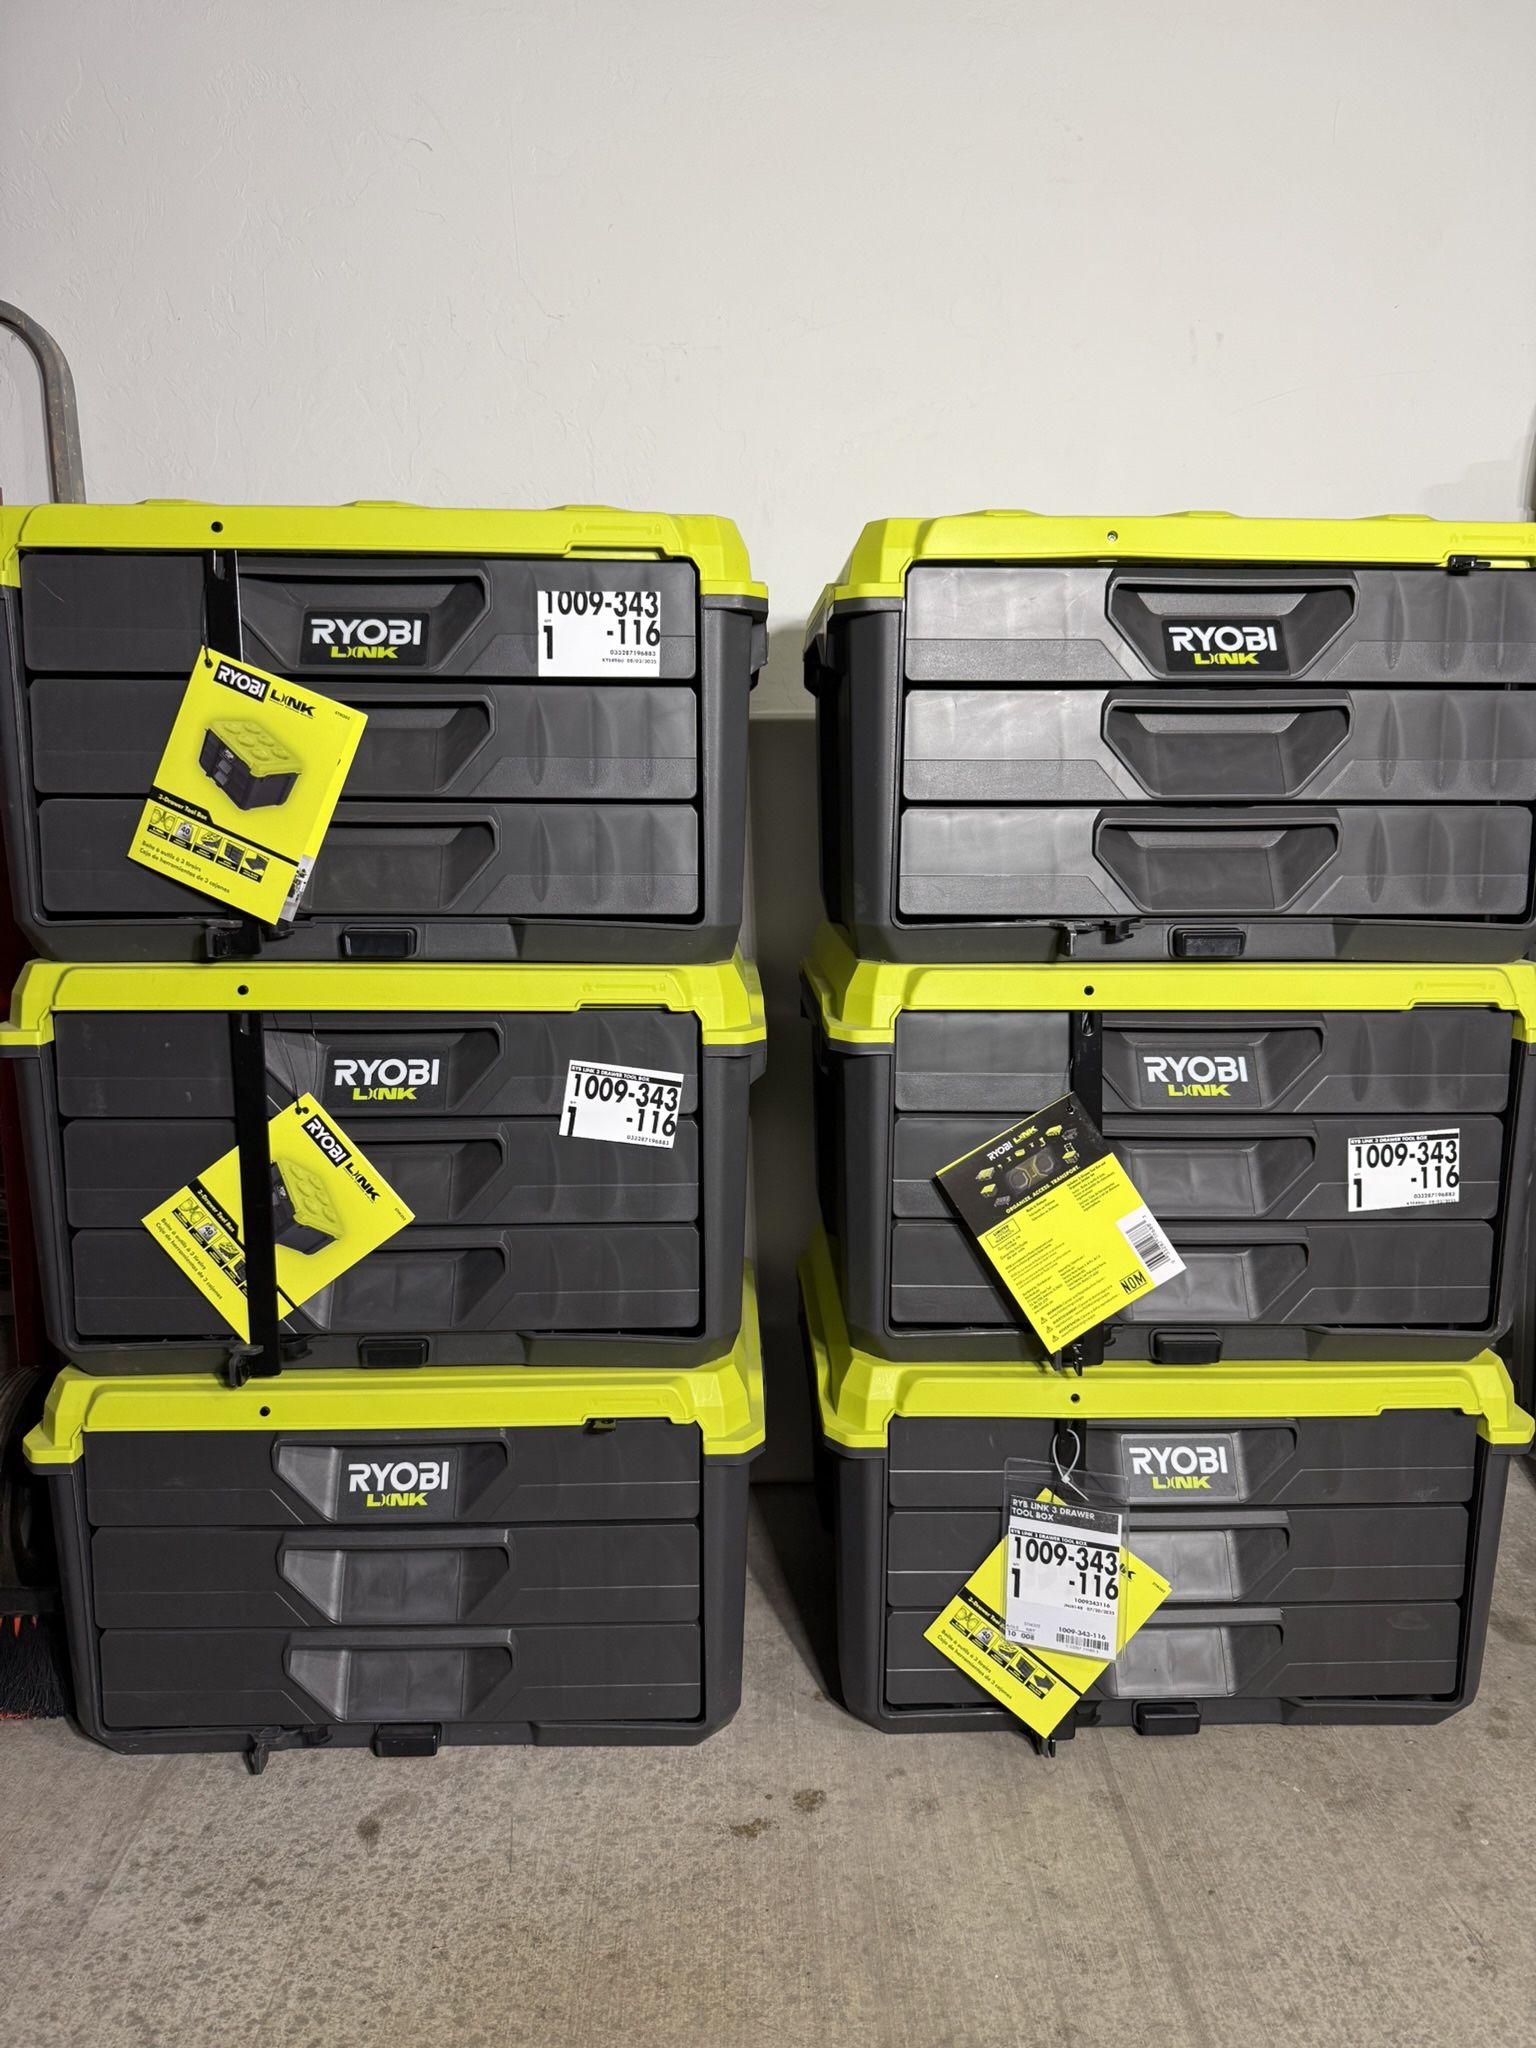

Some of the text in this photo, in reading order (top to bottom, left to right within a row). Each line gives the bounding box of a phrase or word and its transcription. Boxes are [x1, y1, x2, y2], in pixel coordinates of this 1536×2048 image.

[545, 591, 659, 618] 1009-343
[311, 618, 422, 646] RYOBI
[543, 625, 553, 660] 1
[607, 619, 660, 647] -116
[1168, 626, 1278, 652] RYOBI
[330, 646, 399, 659] LINK
[1194, 652, 1260, 665] LINK
[218, 664, 267, 698] RYOBI
[180, 826, 191, 835] 40
[333, 1058, 440, 1086] RYOBI
[1143, 1056, 1249, 1083] RYOBI
[352, 1087, 417, 1101] LINK
[574, 1073, 678, 1112] 1009-343
[1168, 1084, 1230, 1097] LINK
[567, 1105, 577, 1137] 1
[626, 1108, 676, 1137] -116
[306, 1117, 347, 1163] RYOBI
[986, 1140, 1014, 1161] RYOBI
[1355, 1140, 1457, 1168] 1009-343
[1411, 1165, 1460, 1188] -116
[1353, 1178, 1362, 1208] 1
[1120, 1270, 1147, 1294] NOM
[1129, 1446, 1228, 1475] RYOBI
[348, 1461, 450, 1492] RYOBI
[1152, 1475, 1212, 1489] LINK
[366, 1492, 429, 1507] LINK
[1012, 1498, 1095, 1520] RYB LINK 3 DRAWER
[1011, 1507, 1054, 1521] TOOL BOX
[1014, 1536, 1118, 1576] 1009-343
[1011, 1568, 1020, 1598] 1
[1069, 1571, 1119, 1600] -116
[1058, 1626, 1107, 1641] 1009-343-116
